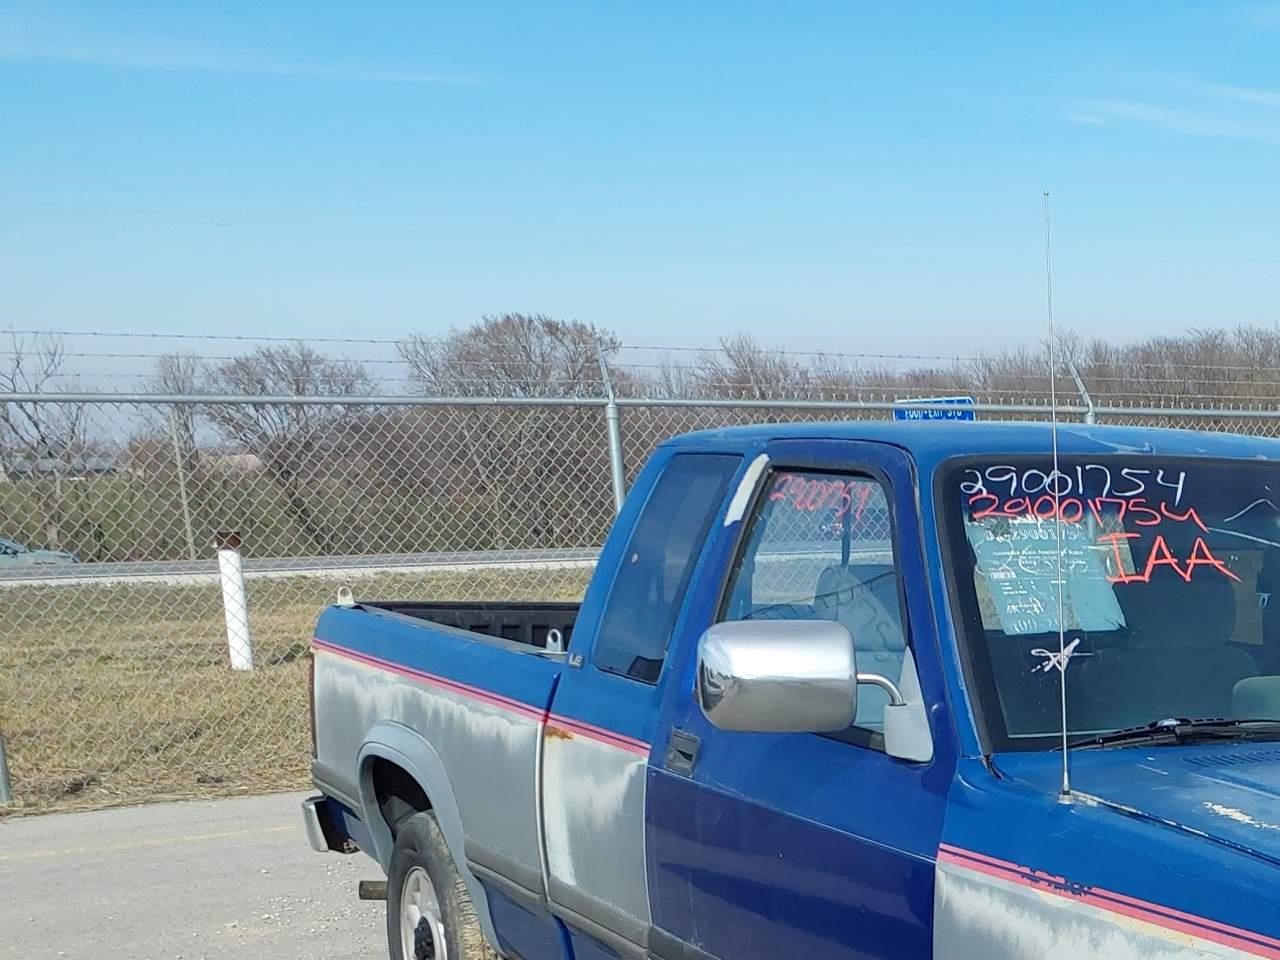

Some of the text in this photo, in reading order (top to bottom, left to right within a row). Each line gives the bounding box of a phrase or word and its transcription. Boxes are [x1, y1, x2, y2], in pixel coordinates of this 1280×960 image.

[961, 465, 1187, 506] 29001754
[969, 494, 1209, 532] 29001754
[1097, 532, 1242, 584] IAA
[568, 653, 583, 668] LE
